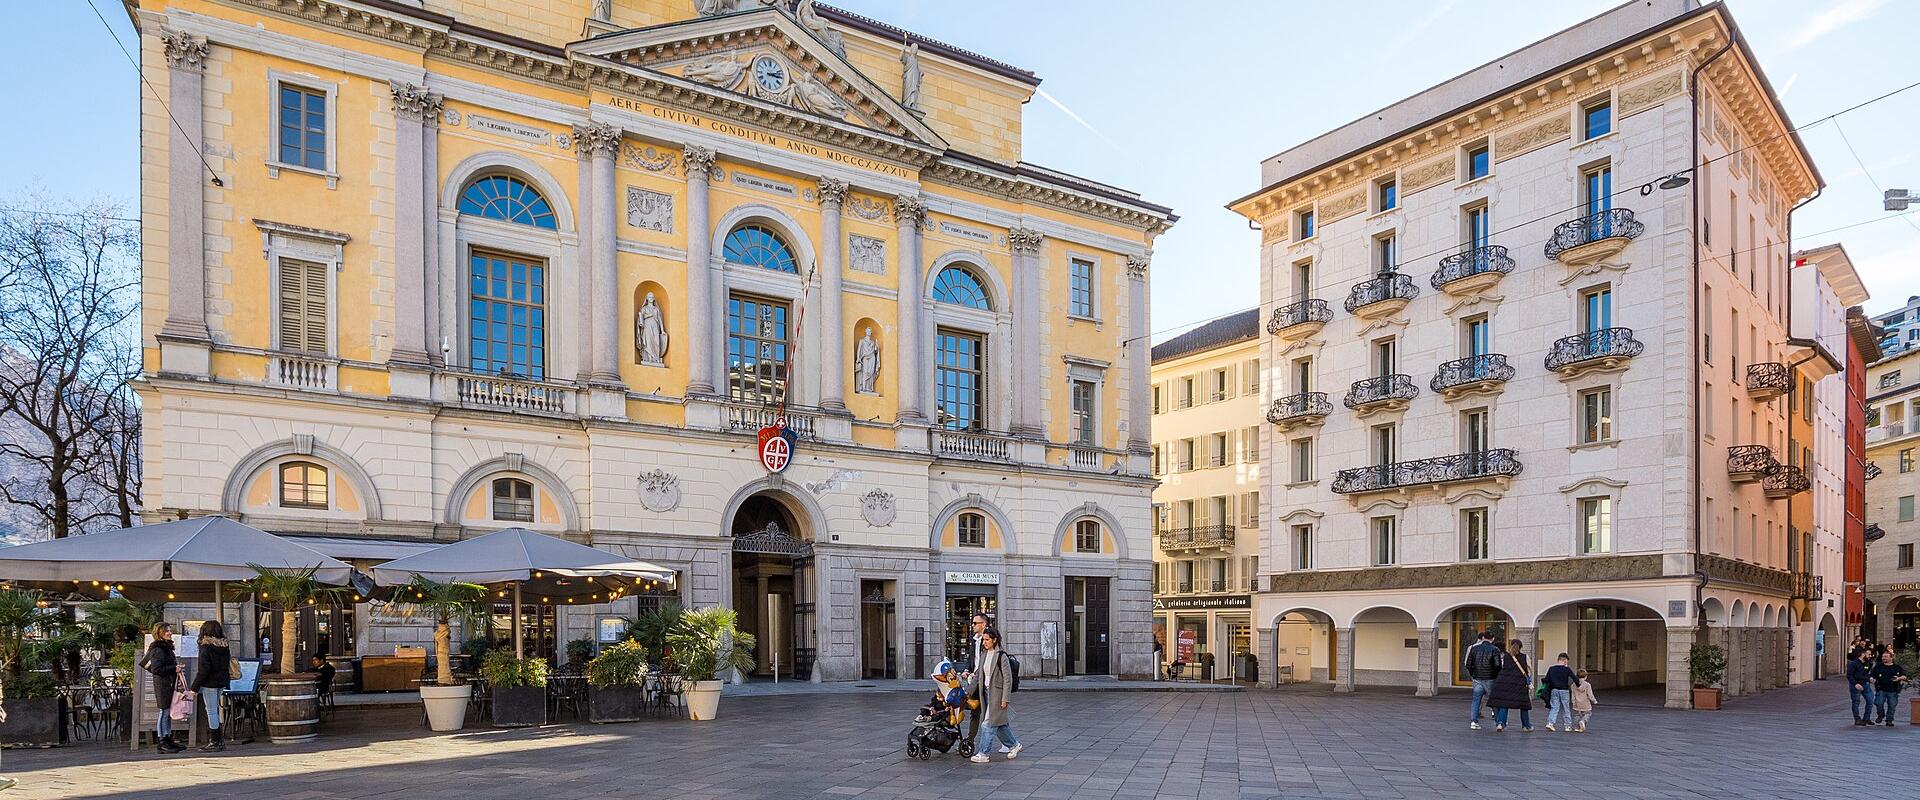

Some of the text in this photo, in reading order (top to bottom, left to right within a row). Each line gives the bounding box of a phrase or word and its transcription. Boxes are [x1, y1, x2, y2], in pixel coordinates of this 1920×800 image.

[514, 128, 541, 138] LIBERTAS
[609, 97, 909, 178] AERE CIVIVM CONDITVM ANNO MDCCCXXXXIV
[1168, 599, 1191, 608] gelateria
